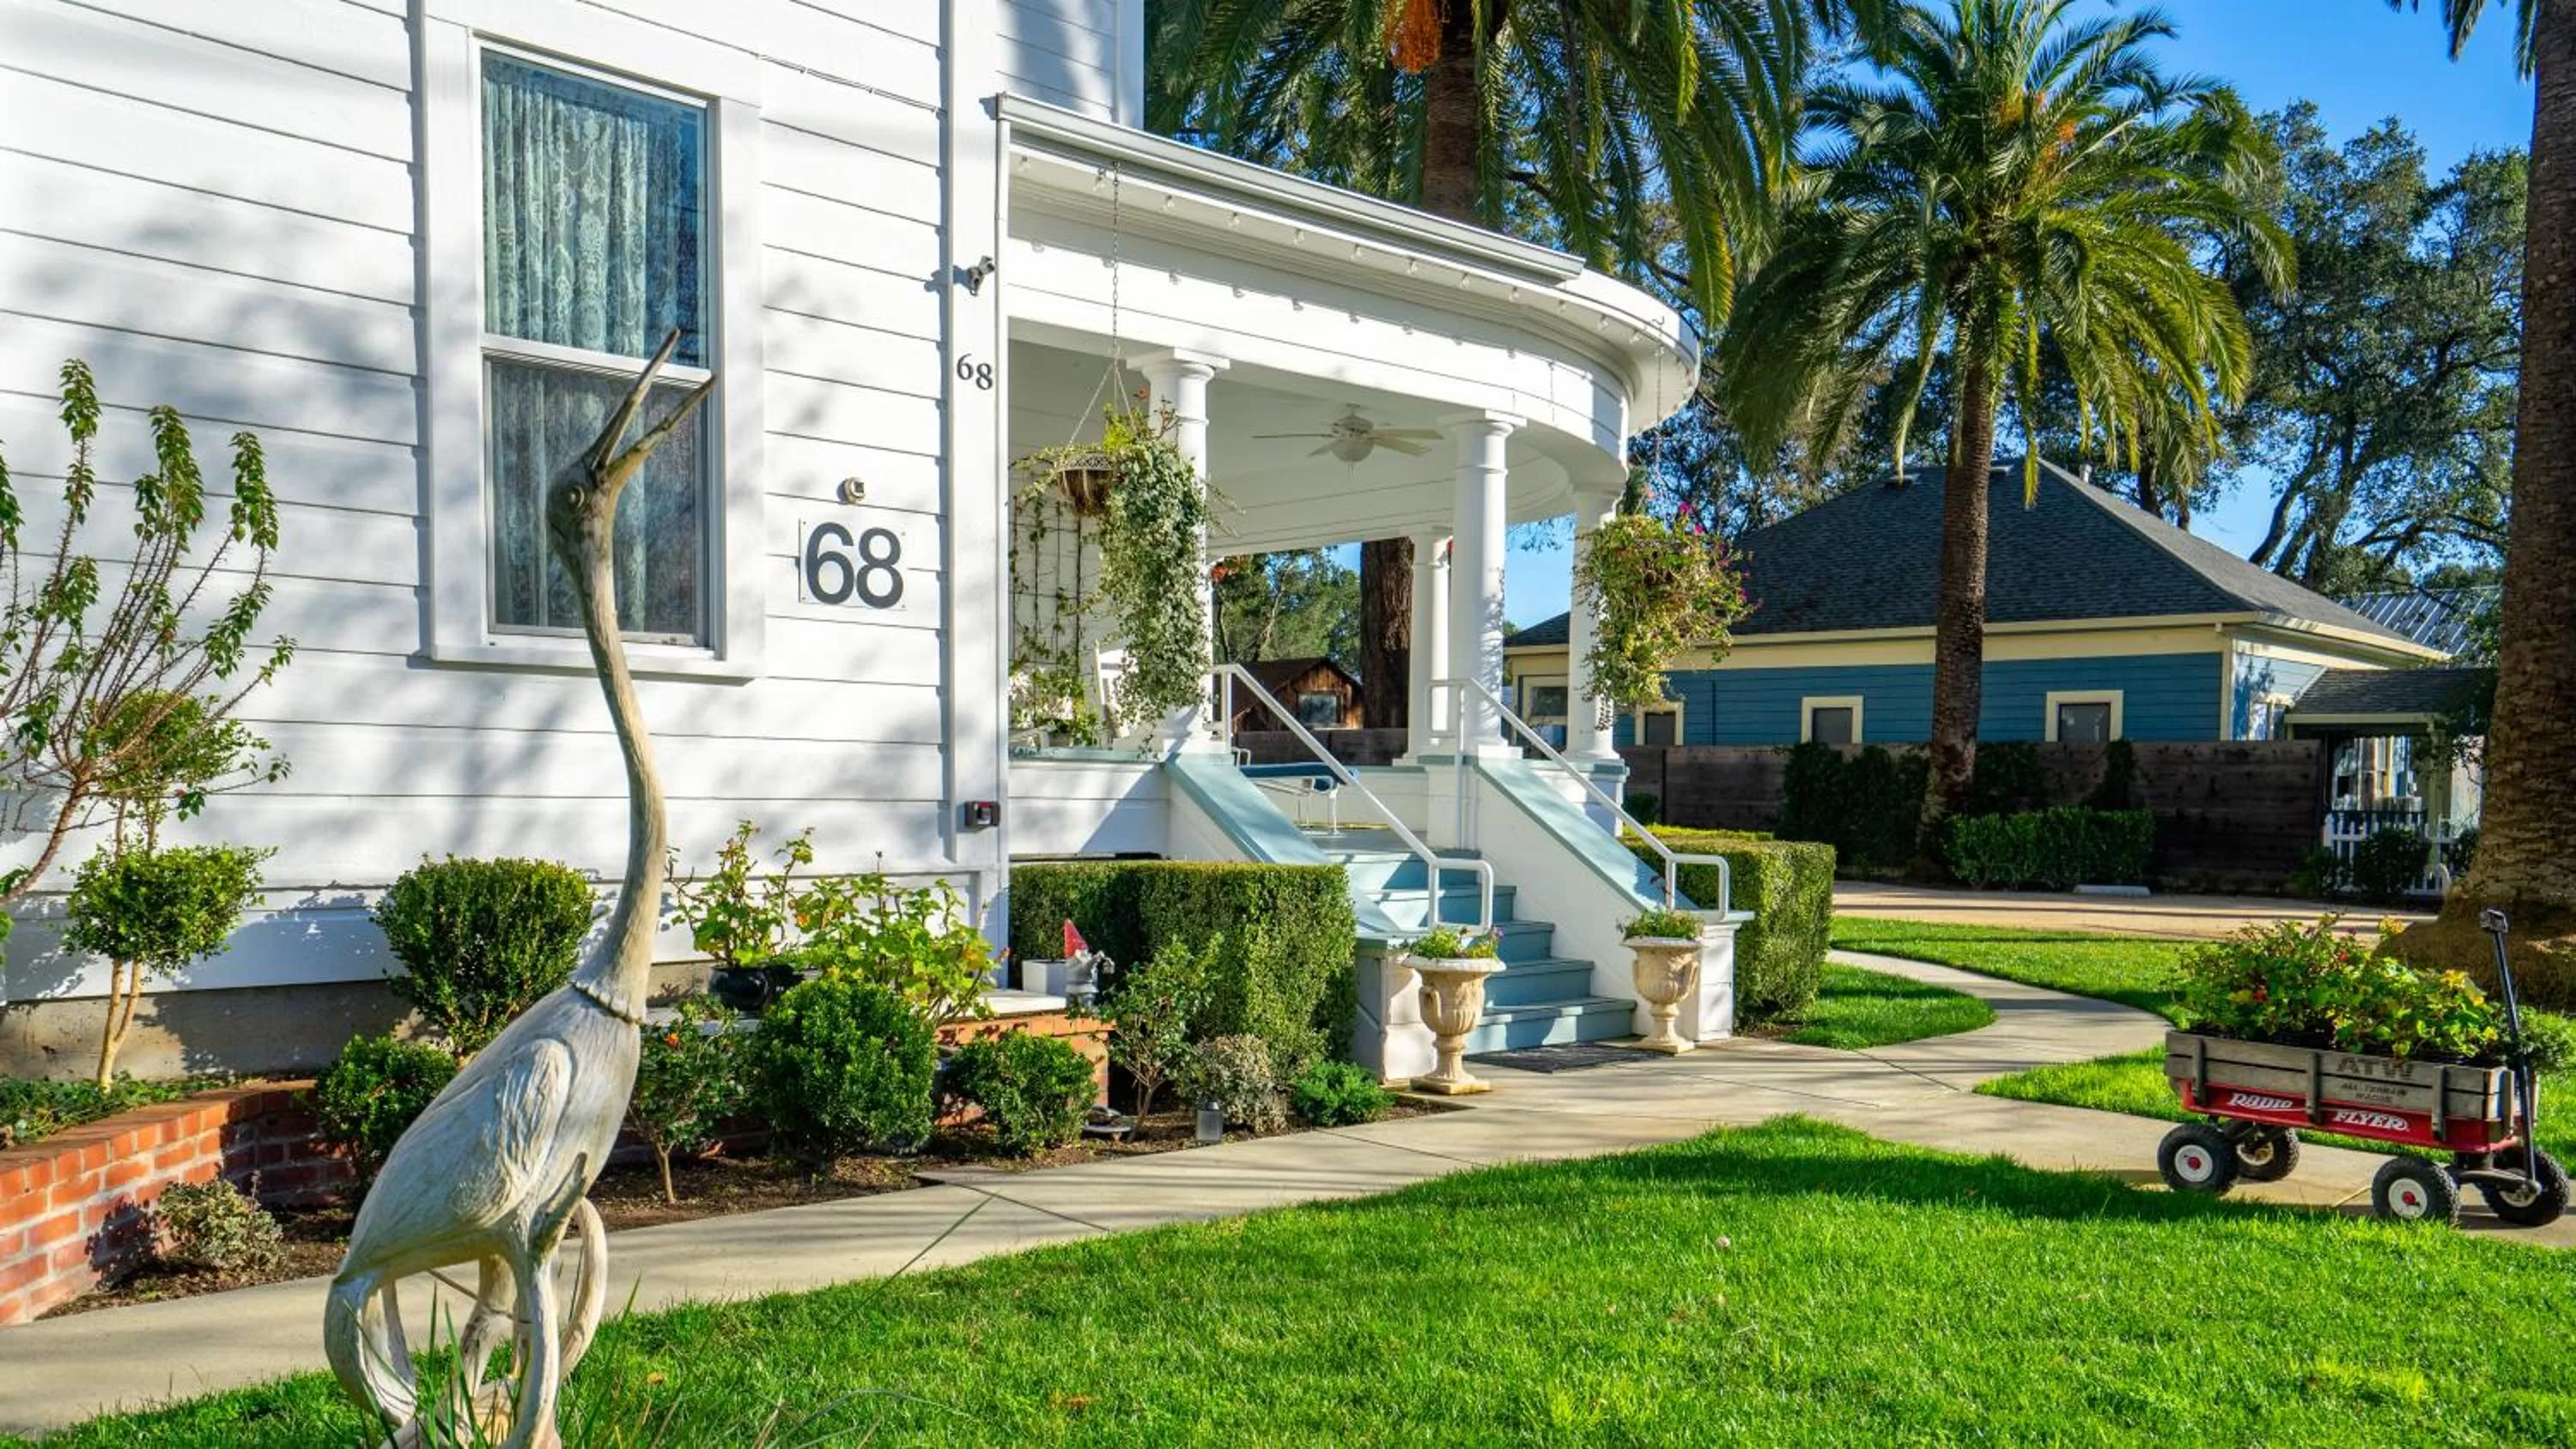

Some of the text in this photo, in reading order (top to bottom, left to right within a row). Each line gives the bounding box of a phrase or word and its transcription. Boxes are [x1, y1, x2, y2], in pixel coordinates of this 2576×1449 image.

[957, 354, 993, 390] 68
[805, 522, 903, 609] 68
[2336, 1057, 2414, 1078] ATW
[2227, 1093, 2409, 1131] RADIO FLYER
